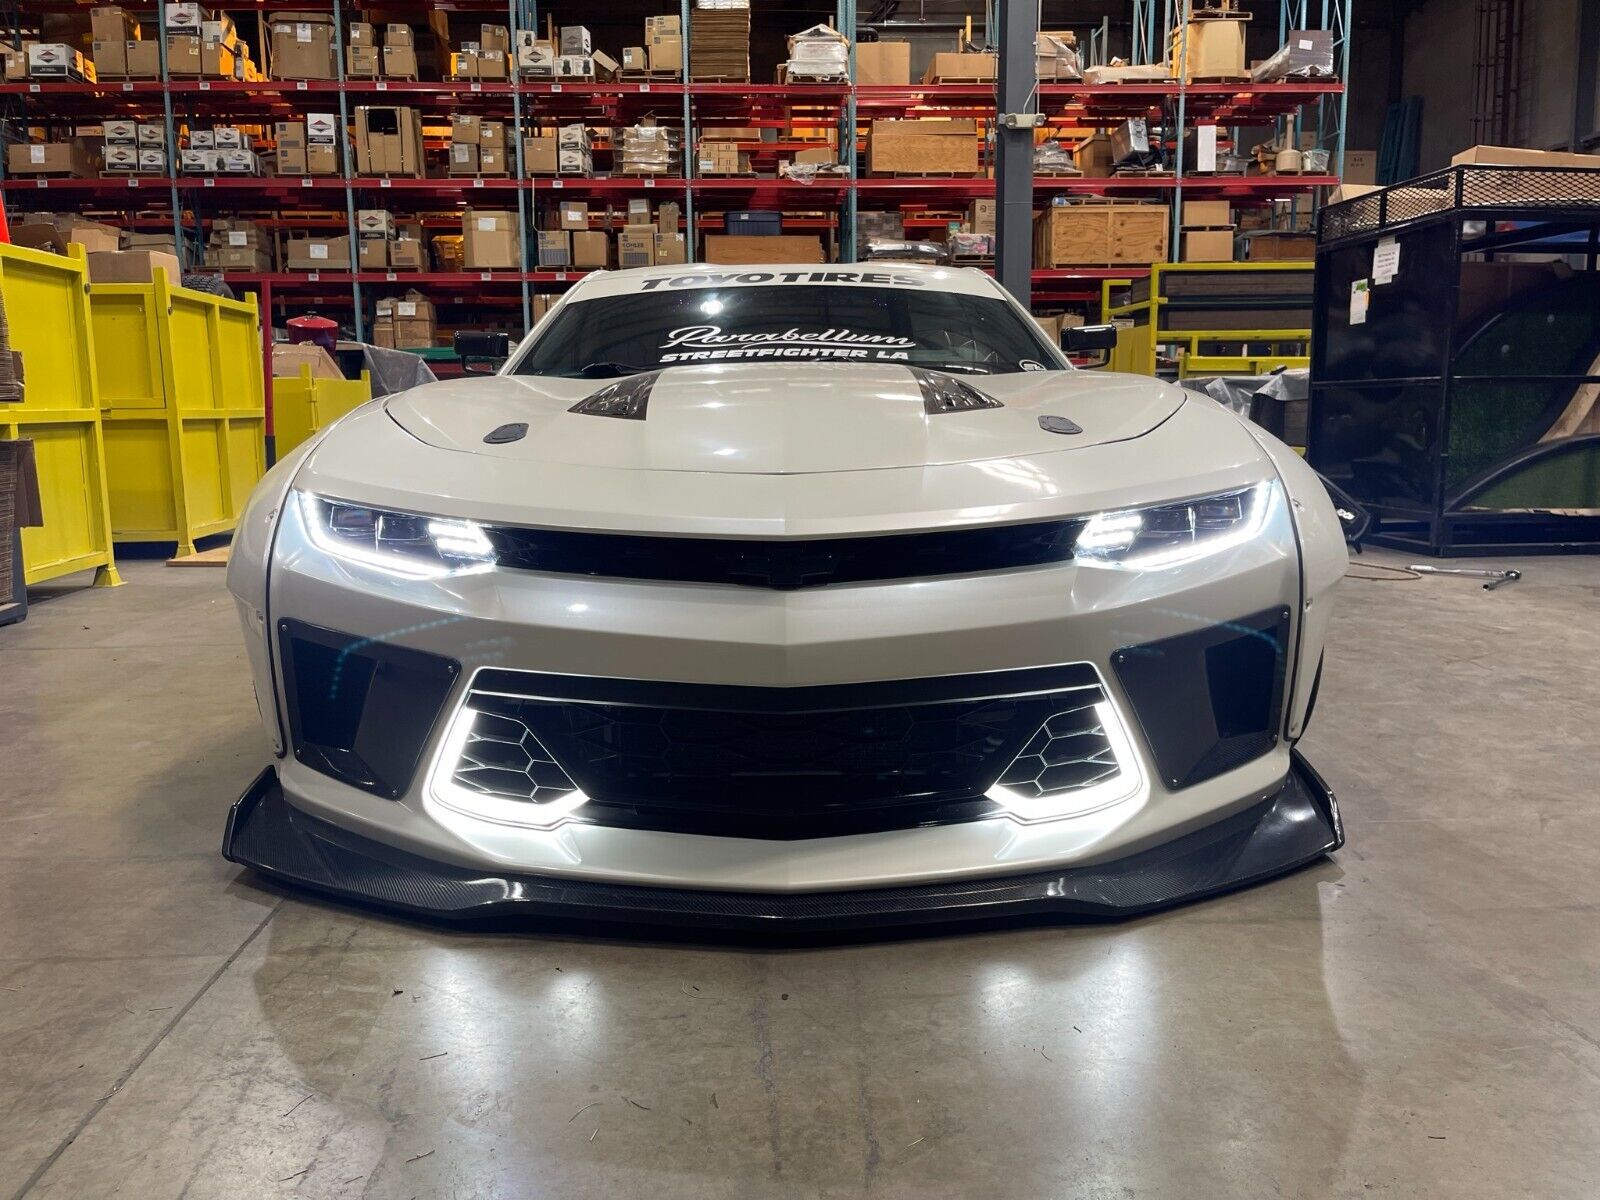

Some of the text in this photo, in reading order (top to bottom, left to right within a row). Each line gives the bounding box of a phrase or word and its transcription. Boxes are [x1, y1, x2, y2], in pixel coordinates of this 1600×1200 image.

[779, 272, 927, 287] TIRES
[658, 325, 917, 348] Parabellum
[659, 348, 909, 363] STREETFIGHTER LA
